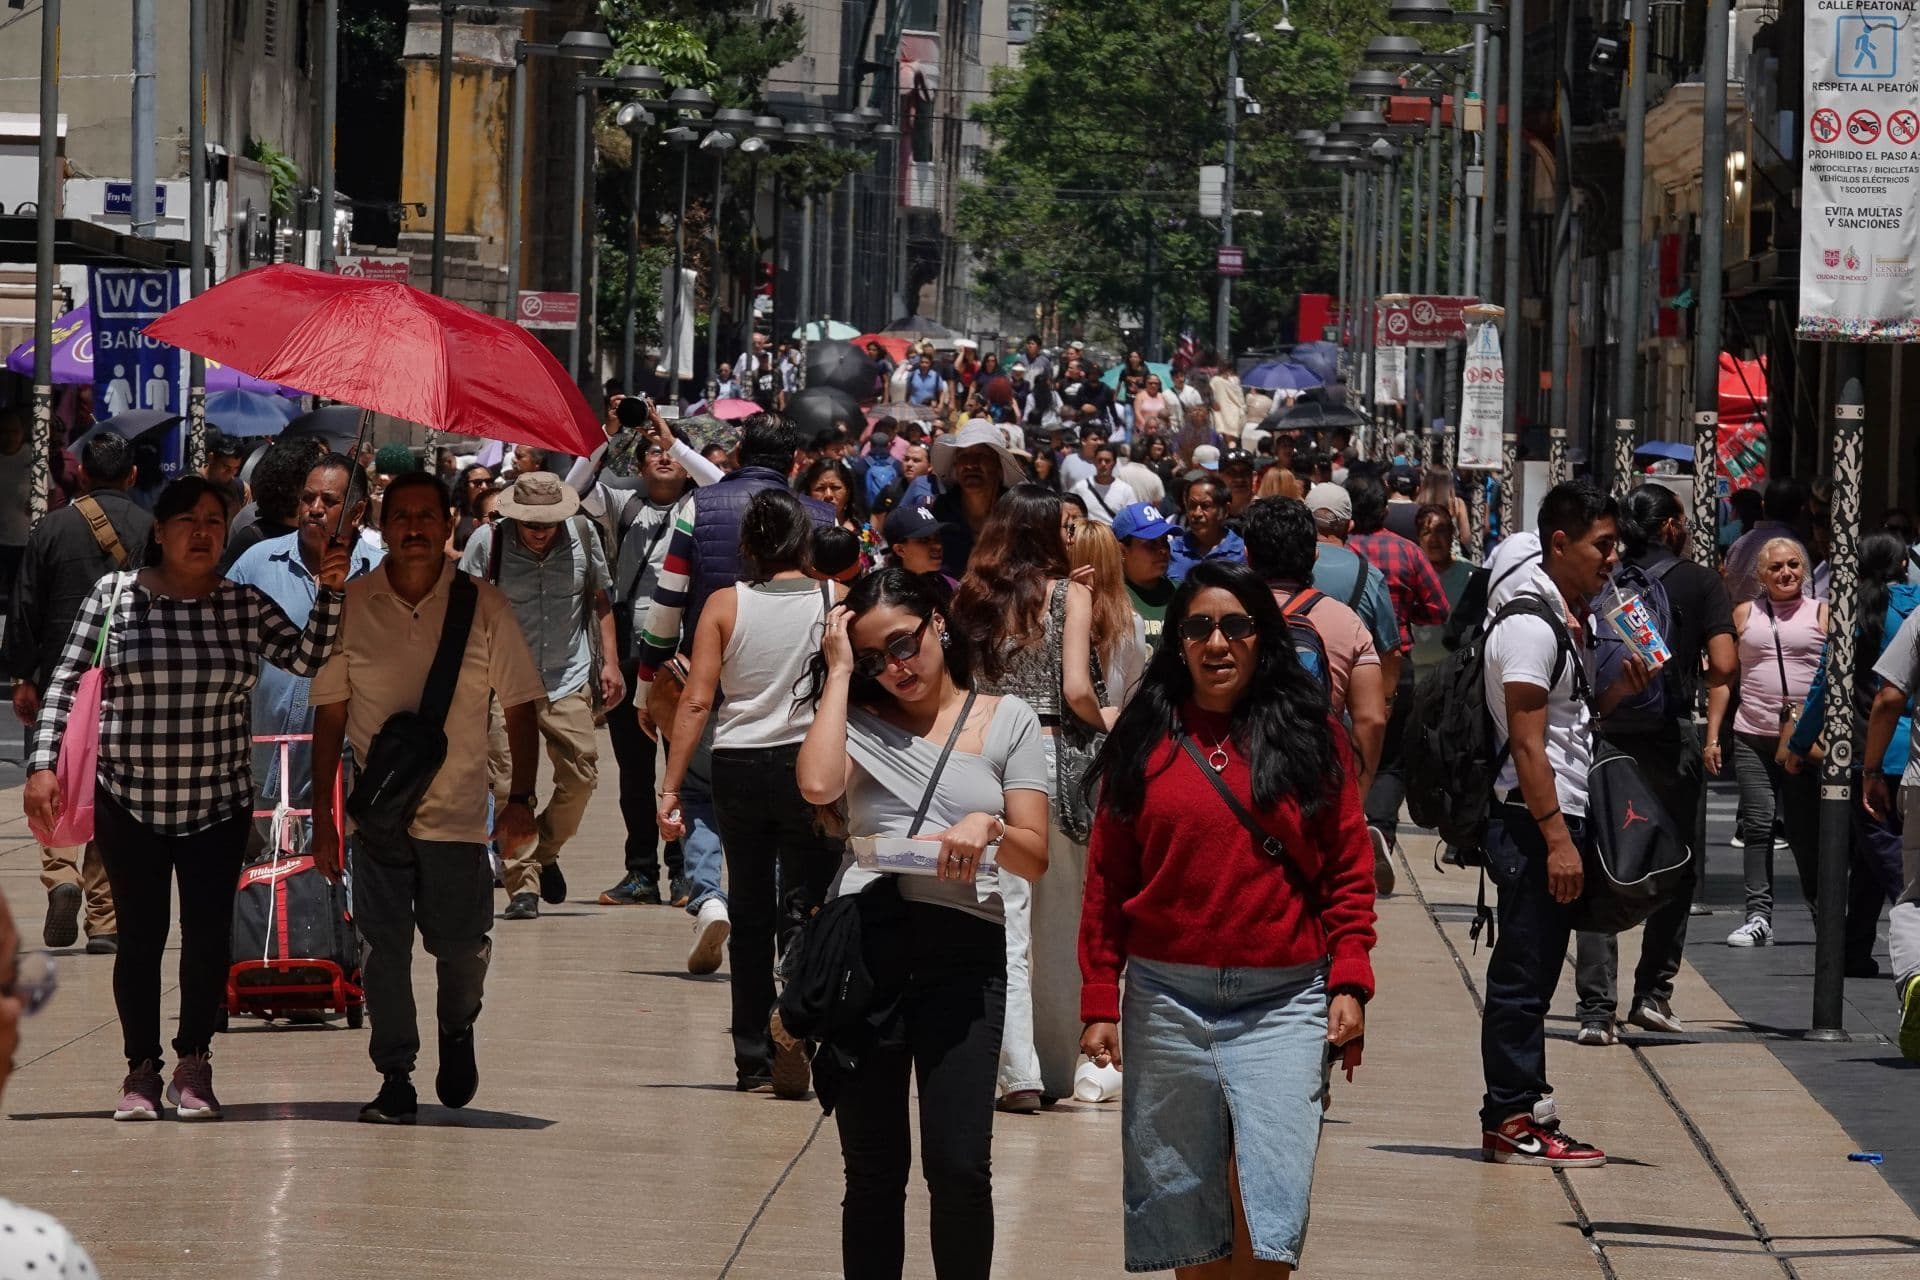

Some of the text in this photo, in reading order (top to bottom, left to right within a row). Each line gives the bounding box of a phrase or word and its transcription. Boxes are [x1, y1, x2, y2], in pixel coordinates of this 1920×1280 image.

[1818, 0, 1917, 11] CALLE PEATONAL
[1812, 81, 1919, 93] RESPETA AL PEATÓN
[1808, 149, 1863, 160] PROHIBIDO
[1865, 151, 1878, 160] EL
[1881, 151, 1908, 160] PASO
[1809, 165, 1868, 173] MOTOCICLETAS
[1874, 166, 1919, 174] BICICLETAS
[1819, 174, 1910, 183] VEHÍCULOS ELÉCTRICOS
[1845, 186, 1887, 194] SCOOTERS
[1825, 206, 1903, 217] EVITA MULTAS
[1827, 218, 1900, 229] Y SANCIONES
[105, 278, 163, 307] WC
